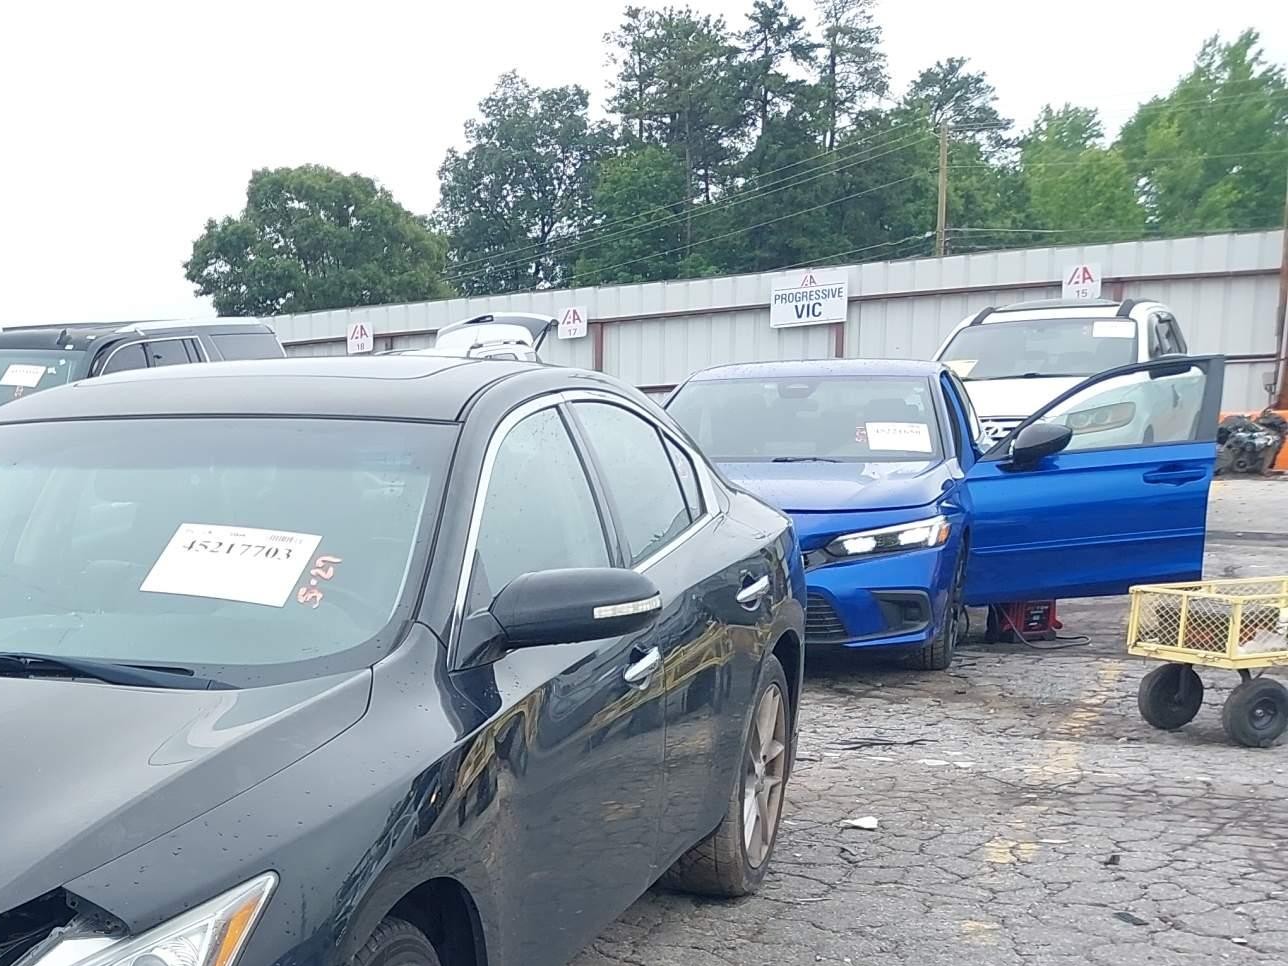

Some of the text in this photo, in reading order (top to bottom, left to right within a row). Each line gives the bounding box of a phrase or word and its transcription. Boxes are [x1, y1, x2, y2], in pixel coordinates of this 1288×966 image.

[774, 286, 844, 305] PROGRESSIVE
[1075, 288, 1089, 298] 15
[794, 301, 823, 319] VIC
[182, 539, 293, 561] 45217703
